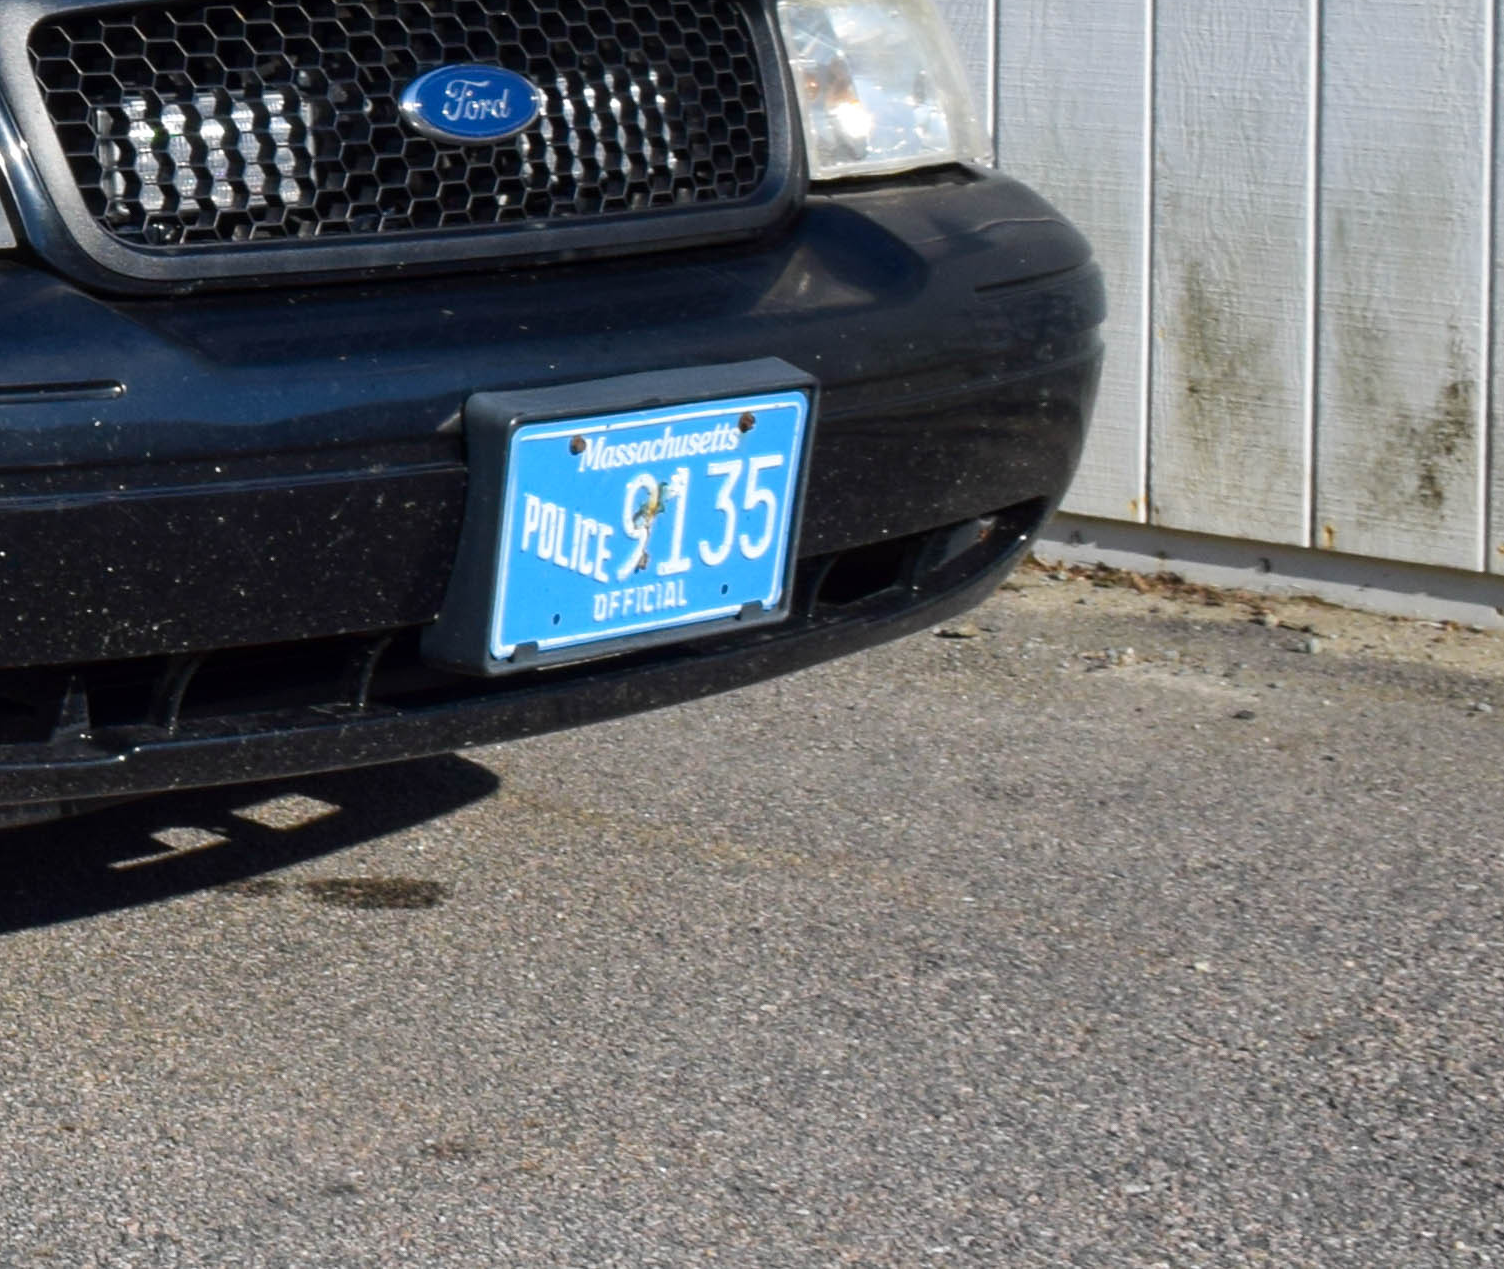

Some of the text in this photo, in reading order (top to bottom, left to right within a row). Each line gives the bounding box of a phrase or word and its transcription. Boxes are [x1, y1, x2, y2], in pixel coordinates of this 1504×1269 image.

[442, 80, 511, 121] Ford
[578, 426, 741, 472] Massachusetts
[521, 454, 784, 583] POLICE 9135
[593, 580, 688, 622] OFFICIAL
